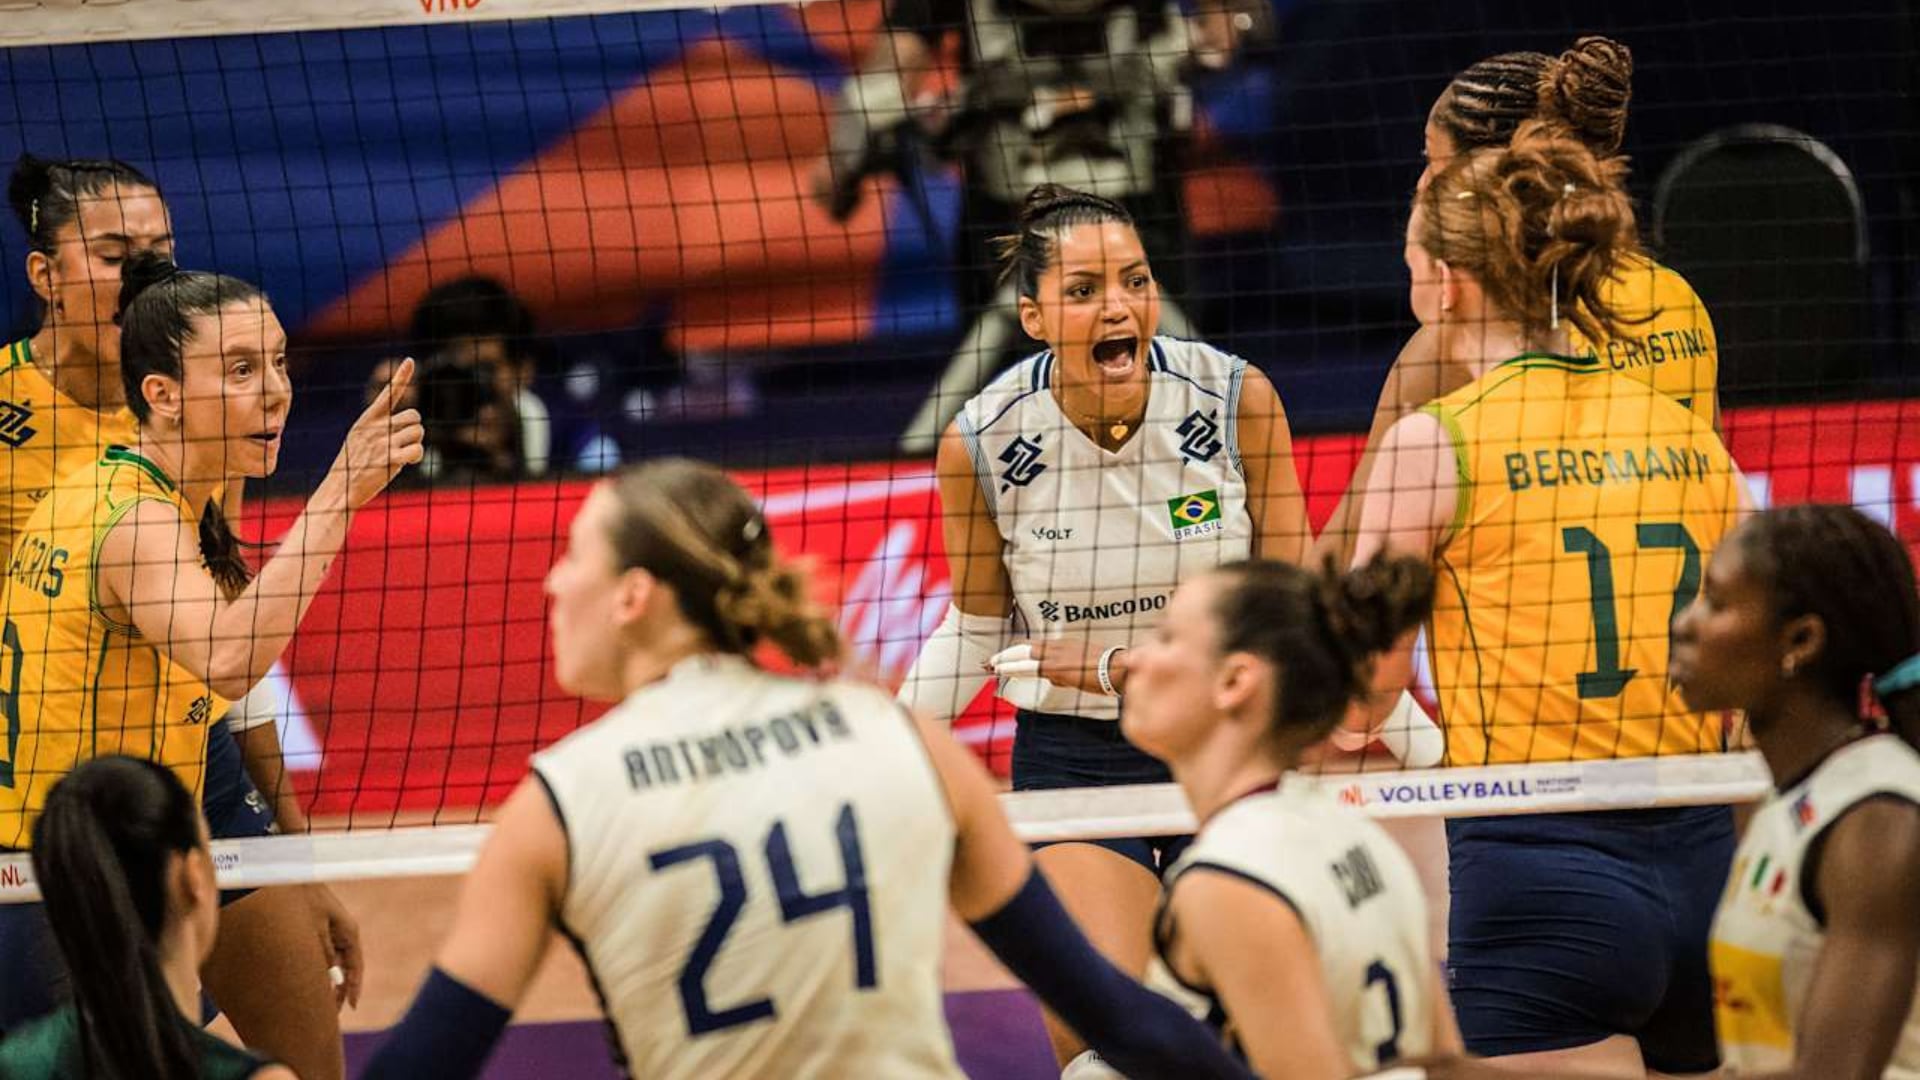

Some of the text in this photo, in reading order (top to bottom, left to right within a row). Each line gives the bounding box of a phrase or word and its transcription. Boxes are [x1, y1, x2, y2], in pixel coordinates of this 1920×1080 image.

[1504, 446, 1710, 492] BERGMANN
[1032, 527, 1073, 540] VOLT
[1174, 521, 1224, 540] BRASIL
[1064, 595, 1167, 623] BANCO DO
[1562, 522, 1702, 699] 17
[1380, 779, 1532, 803] VOLLEYBALL
[650, 803, 877, 1036] 24
